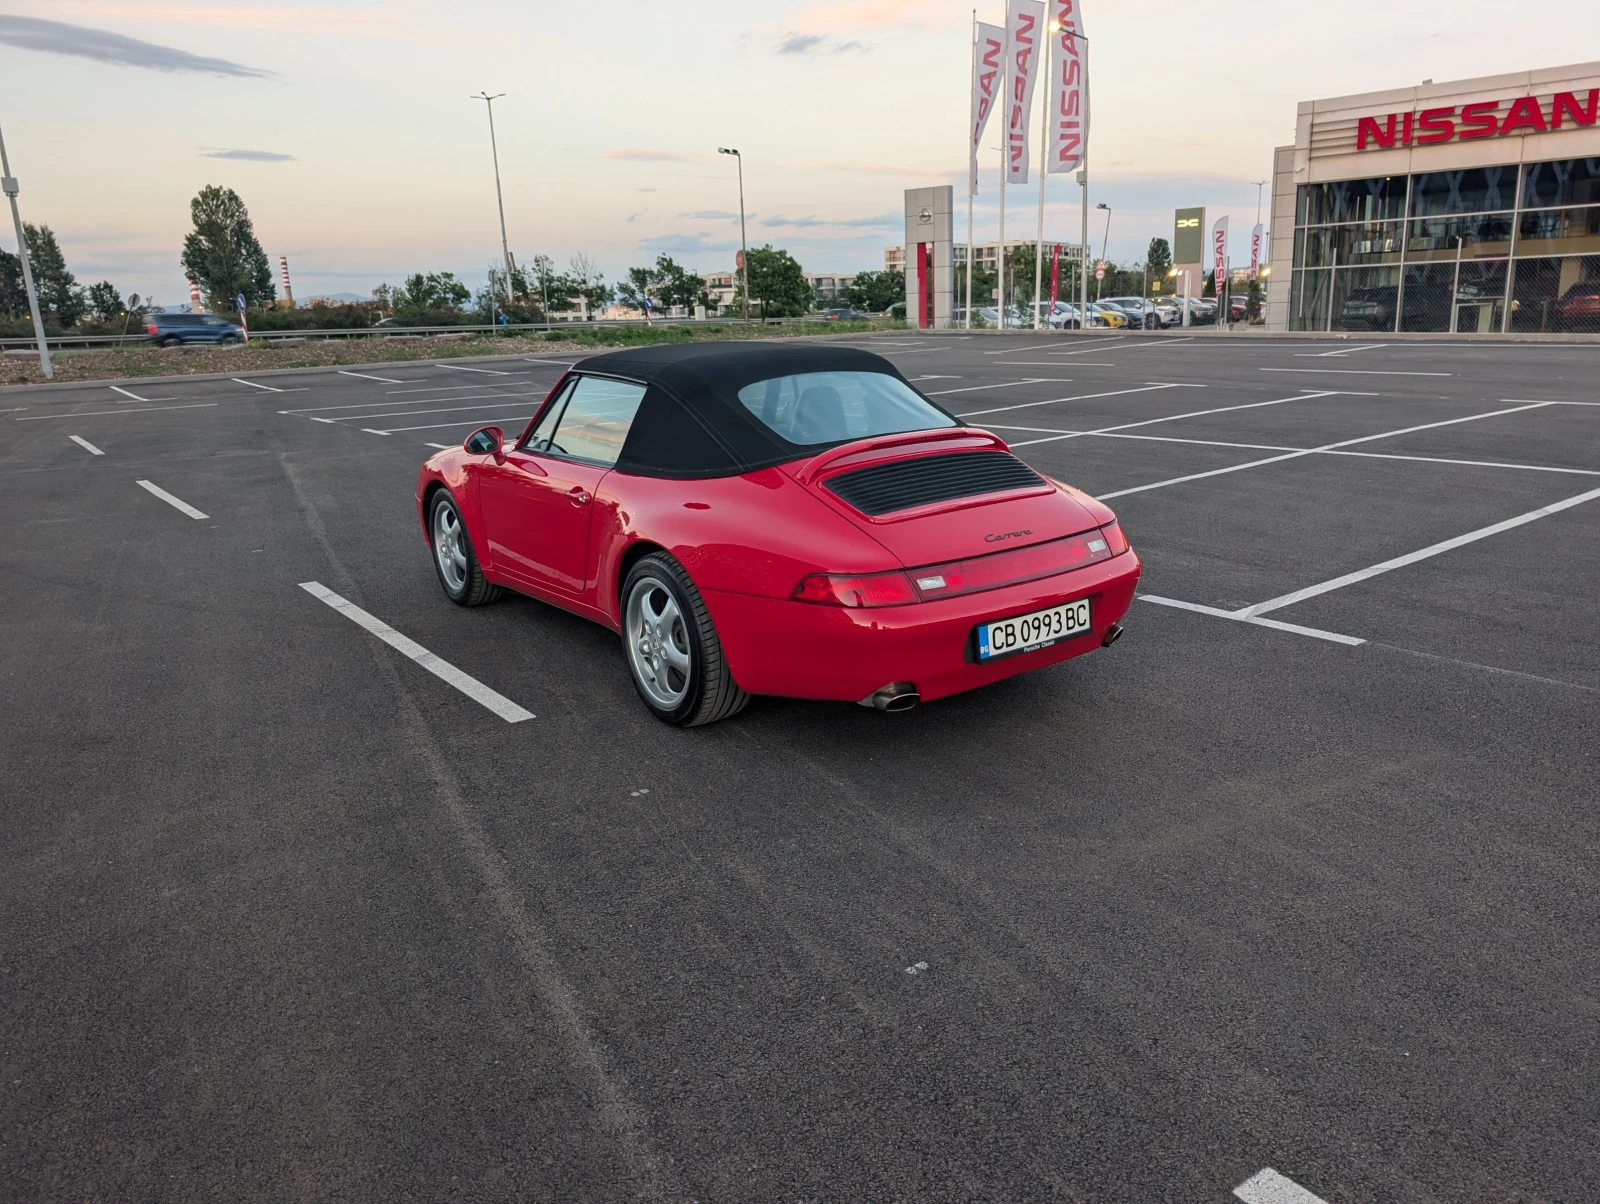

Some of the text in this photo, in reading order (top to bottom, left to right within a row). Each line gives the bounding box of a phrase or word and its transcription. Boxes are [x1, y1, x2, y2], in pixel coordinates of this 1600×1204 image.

[1059, 0, 1081, 162] NISSAN
[1356, 88, 1600, 150] NISSAN
[984, 529, 1034, 542] Carrera
[992, 604, 1087, 650] CB 0993 BC
[980, 645, 989, 654] BG
[1023, 640, 1055, 653] Porsche Classic
